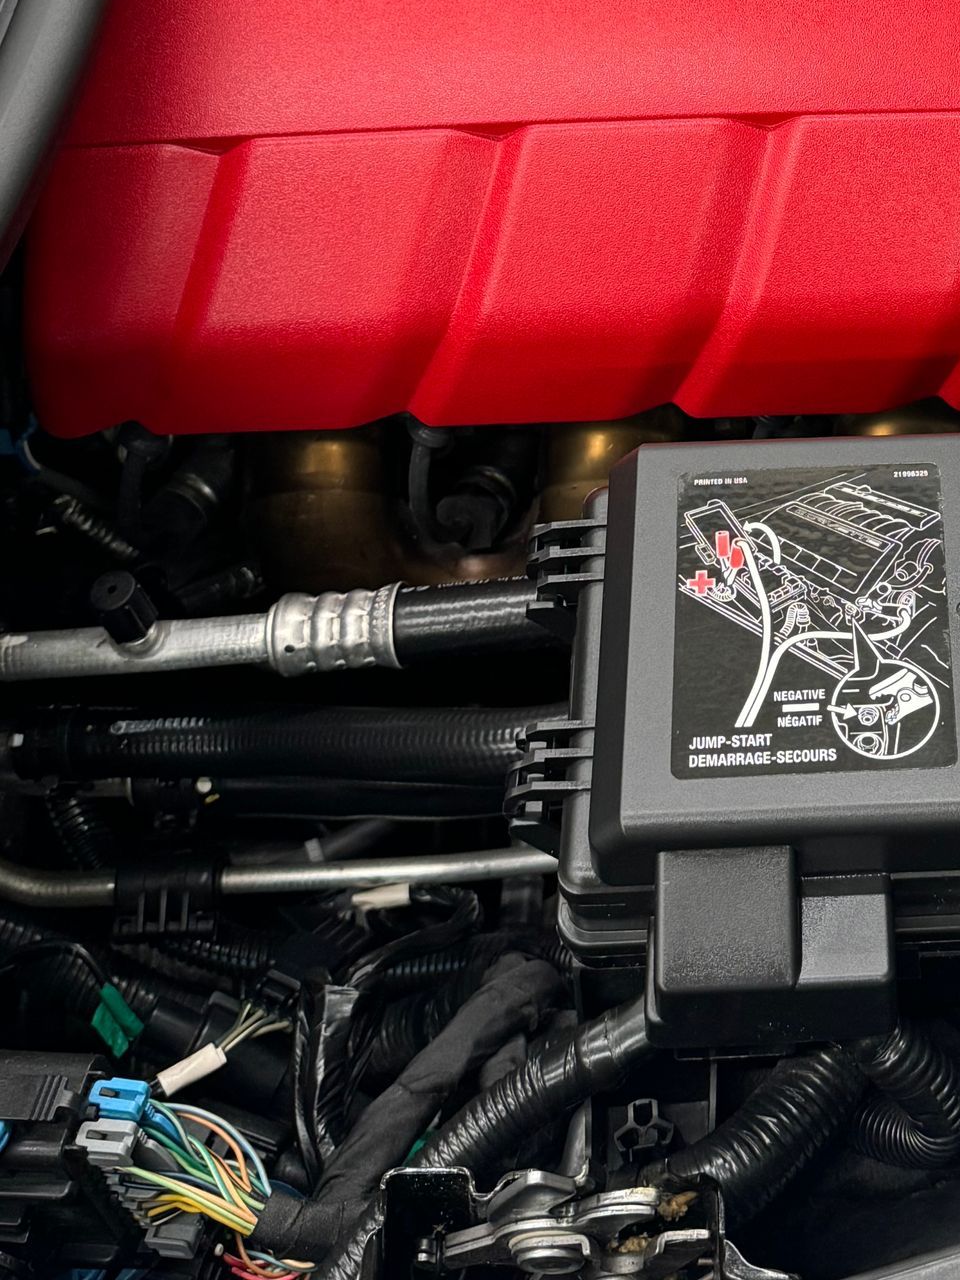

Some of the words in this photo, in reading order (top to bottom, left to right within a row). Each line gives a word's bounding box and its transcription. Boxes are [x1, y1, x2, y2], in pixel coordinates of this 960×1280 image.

[694, 478, 723, 486] PRINTED
[773, 689, 826, 702] NEGATIVE
[777, 715, 823, 728] NÉGATIF
[689, 733, 773, 750] JUMP-START
[688, 748, 837, 768] DEMARRAGE-SECOURS
